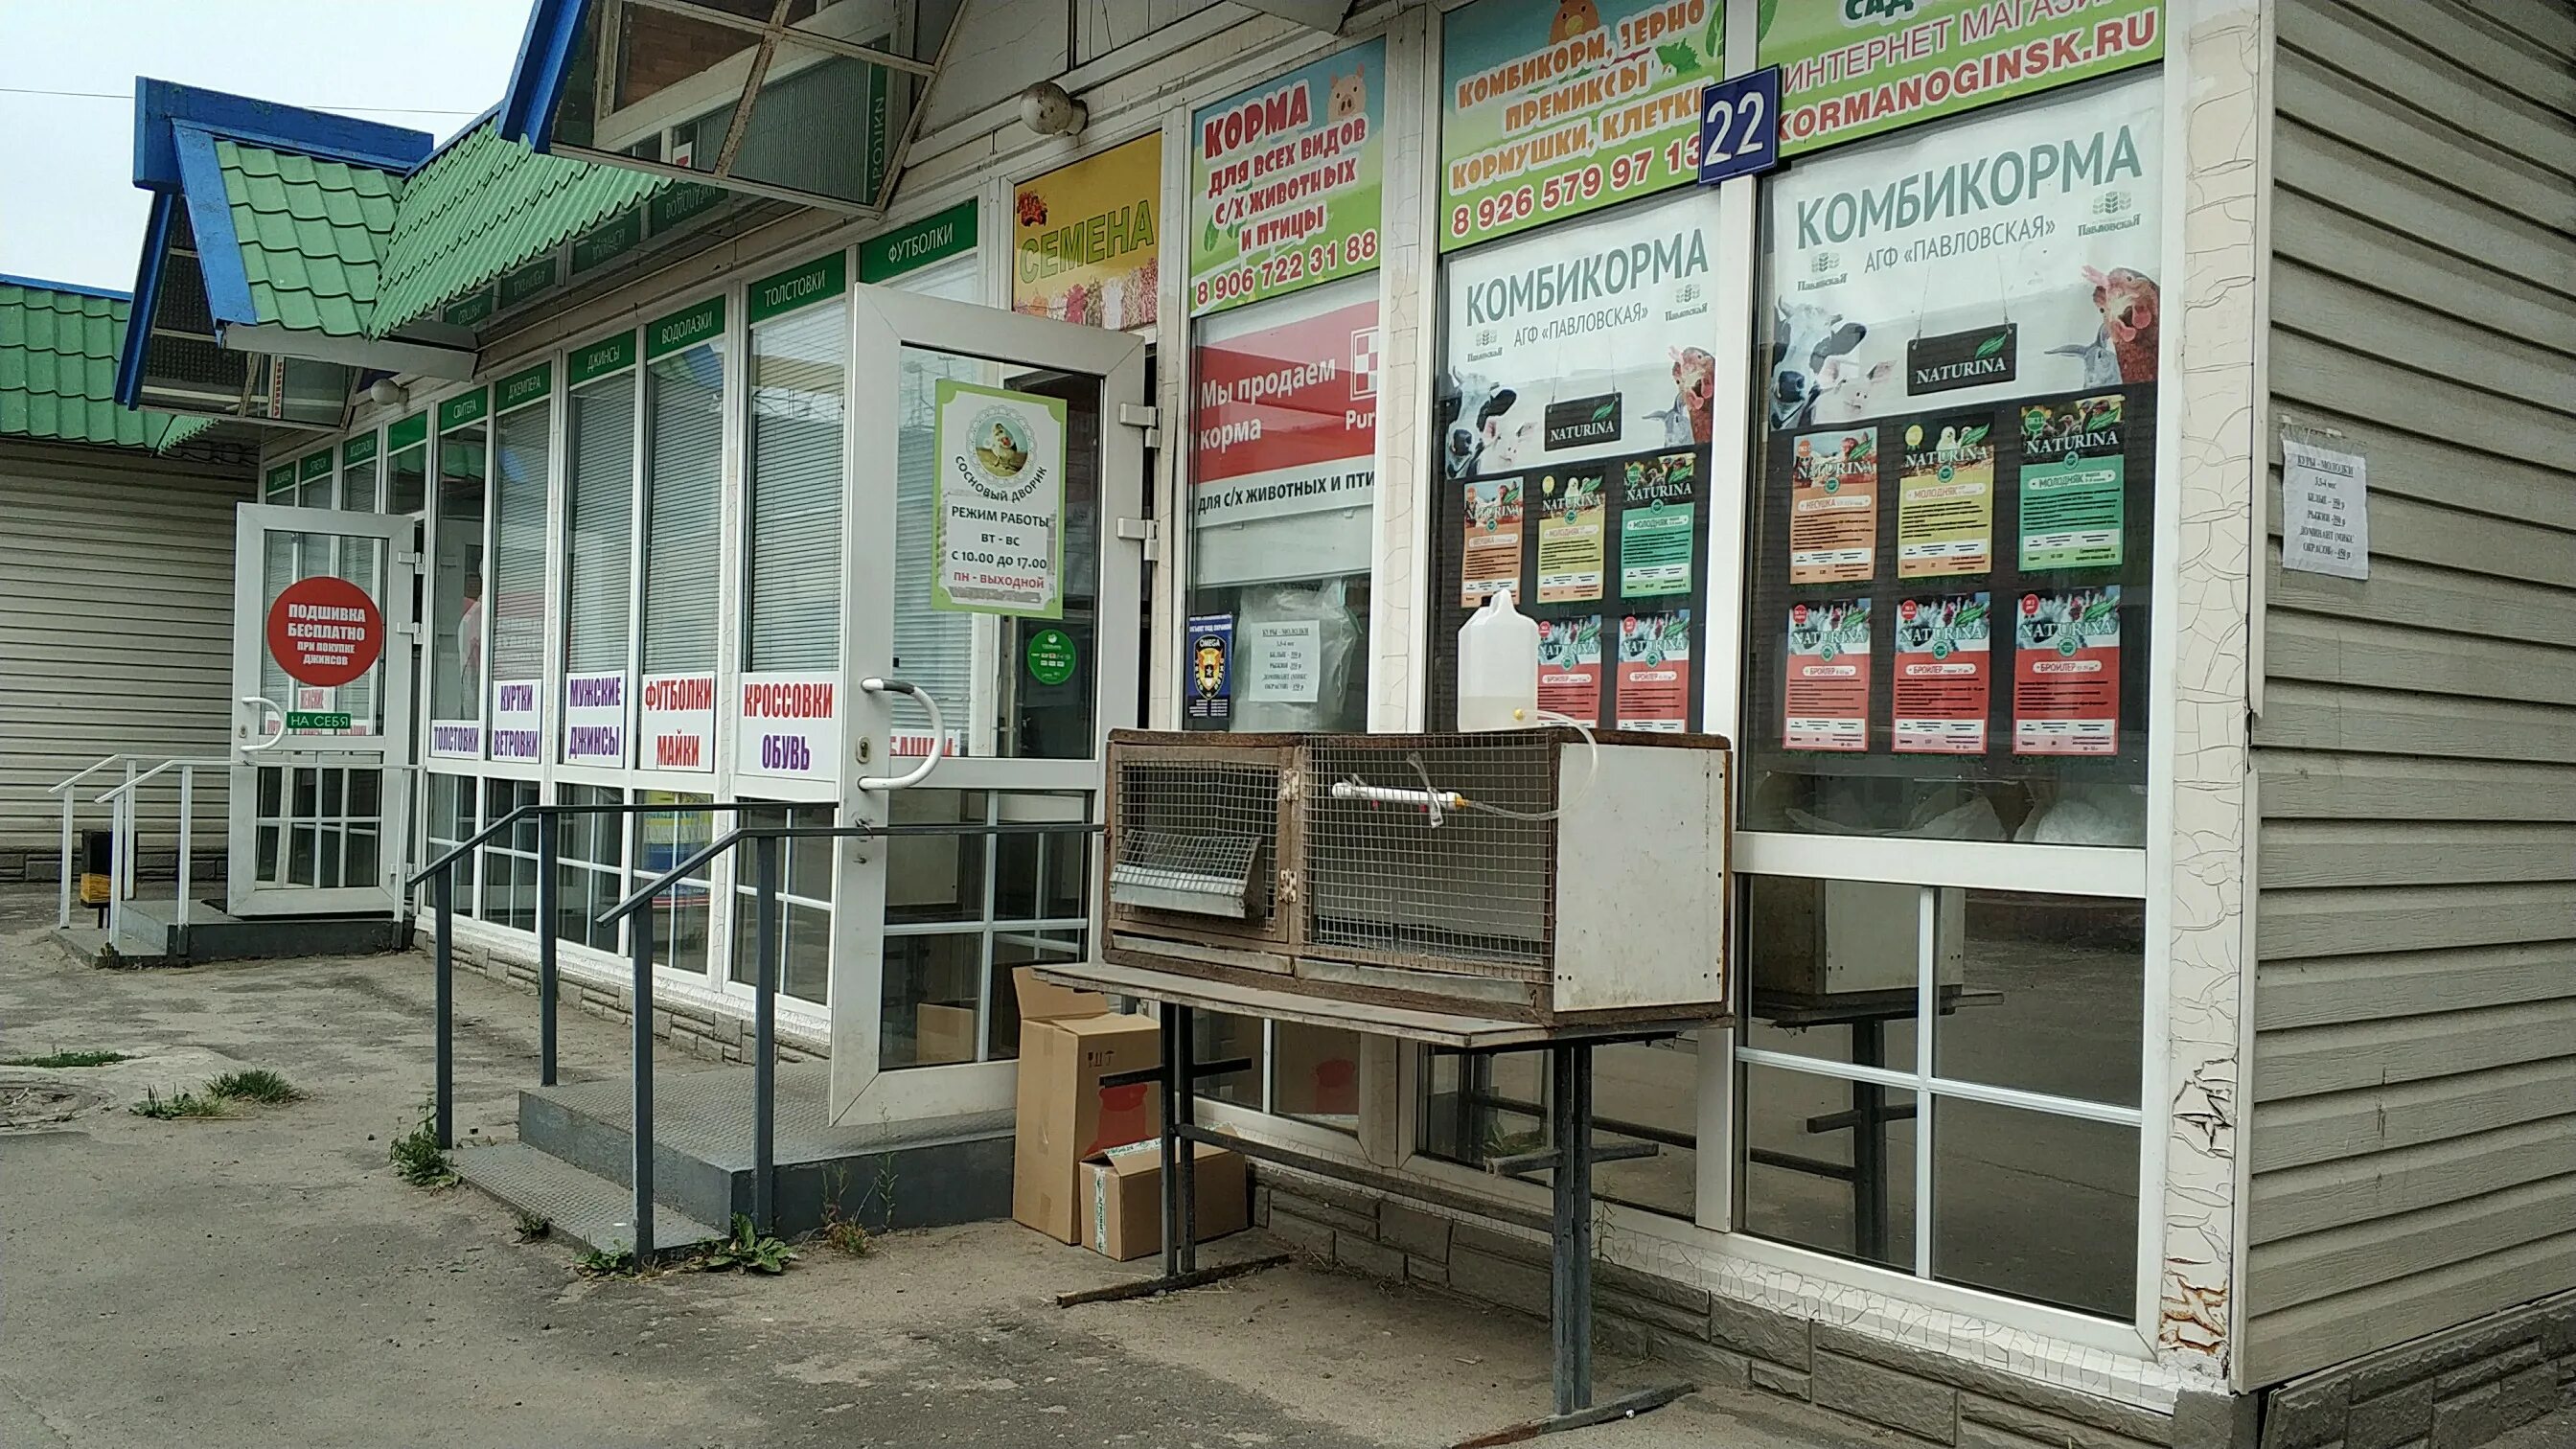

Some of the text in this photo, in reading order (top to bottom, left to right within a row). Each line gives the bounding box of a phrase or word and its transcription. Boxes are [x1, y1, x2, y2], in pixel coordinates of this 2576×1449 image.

[1459, 0, 1705, 109] КОМБИКОРМ, ЗЕРНО
[1784, 0, 2101, 94] ИНТЕРНЕТ МАГА
[1779, 12, 2155, 141] KORMANOGINSK.RU
[1506, 60, 1648, 132] ПРЕМИКСЫ
[1205, 85, 1308, 159] КОРМА
[1704, 92, 1764, 167] 22
[1208, 118, 1366, 198] ДЛЯ ВСЕХ ВИДОВ
[1453, 124, 1594, 190] КОРМУШКИ,
[1215, 158, 1356, 226] С/Х ЖИВОТНЫХ
[1453, 206, 1469, 236] 8
[1478, 187, 1532, 227] 926
[1542, 166, 1601, 209] 579
[1612, 150, 1653, 189] 97
[1797, 125, 2143, 250] КОМБИКОРМА
[888, 222, 954, 264] ФУТБОЛКИ
[1020, 199, 1155, 285] СЕМЕНА
[1241, 205, 1324, 252] И ПТИЦЫ
[1864, 215, 2056, 274] АГФ «ПАВЛОВСКАЯ»
[1197, 231, 1377, 306] 8 906 722 31 88
[1466, 228, 1709, 327] КОМБИКОРМА
[765, 269, 826, 309] ТОЛСТОВКИ
[661, 311, 712, 346] ВОДОЛАЗКИ
[1514, 302, 1648, 348] АГФ «ПАВЛОВСКАЯ»
[587, 345, 620, 373] ДЖИНСЫ
[1917, 356, 2007, 384] NATURINA
[1201, 358, 1336, 410] Мы продаем
[1201, 419, 1262, 453] корма
[1346, 409, 1375, 430] Pur
[1550, 420, 1615, 443] NATURINA
[1905, 447, 1988, 468] NATURINA
[2026, 430, 2119, 454] NATURINA
[955, 455, 1047, 503] СОСНОВЫЙ ДВОРИК
[1798, 460, 1874, 479] NATURINA
[1198, 471, 1374, 516] для с/х животных и пти
[1542, 492, 1601, 513] NATURINA
[1626, 482, 1693, 502] NATURINA
[952, 506, 1049, 528] РЕЖИМ РАБОТЫ
[981, 533, 996, 543] ВТ
[1005, 536, 1021, 546] ВС
[952, 550, 958, 561] С
[962, 551, 994, 564] 10.00
[1017, 557, 1046, 570] 17.00
[954, 571, 970, 582] ПН
[980, 574, 1045, 589] ВЫХОДНОЙ
[288, 604, 366, 623] ПОДШИВКА
[2022, 623, 2114, 638] NATURINA
[288, 623, 365, 641] БЕСПЛАТНО
[297, 641, 356, 654] ПРИ ПОКУПКЕ
[1200, 638, 1221, 648] OMEGA
[1793, 631, 1866, 645] NATURINA
[1901, 627, 1984, 642] NATURINA
[303, 654, 348, 665] ДЖИНСОВ
[500, 684, 533, 712] КУРТКИ
[569, 677, 621, 708] МУЖСКИЕ
[644, 678, 712, 711] ФУТБОЛКИ
[744, 682, 833, 719] КРОССОВКИ
[291, 716, 348, 727] НА СЕБЯ
[433, 725, 478, 753] ТОЛСТОВКИ
[494, 729, 539, 759] ВЕТРОВКИ
[568, 725, 620, 761] ДЖИНСЫ
[656, 729, 700, 768] МАЙКИ
[762, 734, 810, 770] ОБУВЬ
